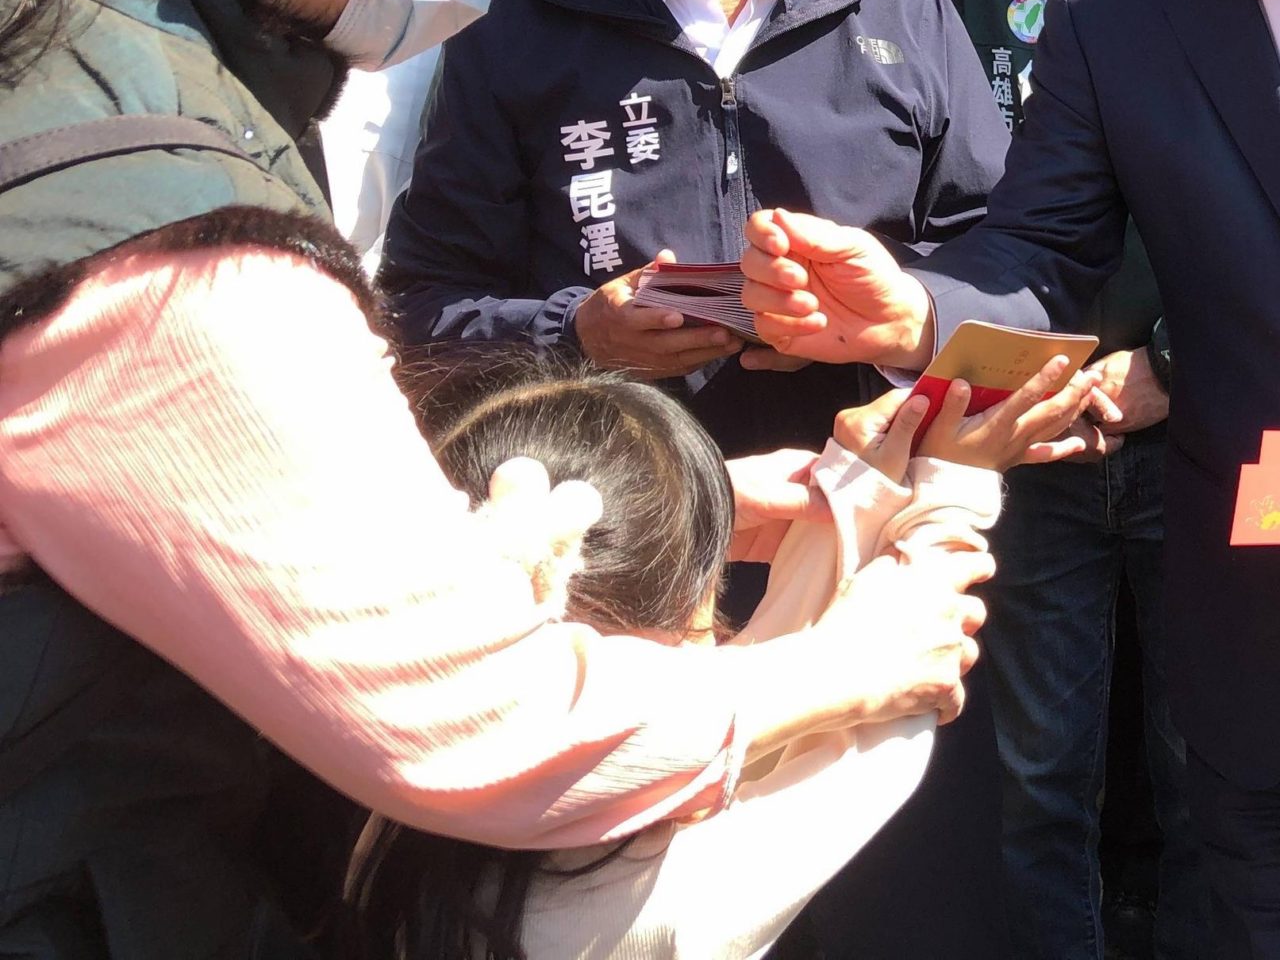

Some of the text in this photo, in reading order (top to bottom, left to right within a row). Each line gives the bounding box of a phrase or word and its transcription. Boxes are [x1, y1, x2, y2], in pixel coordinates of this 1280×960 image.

[619, 92, 661, 165] 立委
[560, 119, 624, 277] 李昆澤
